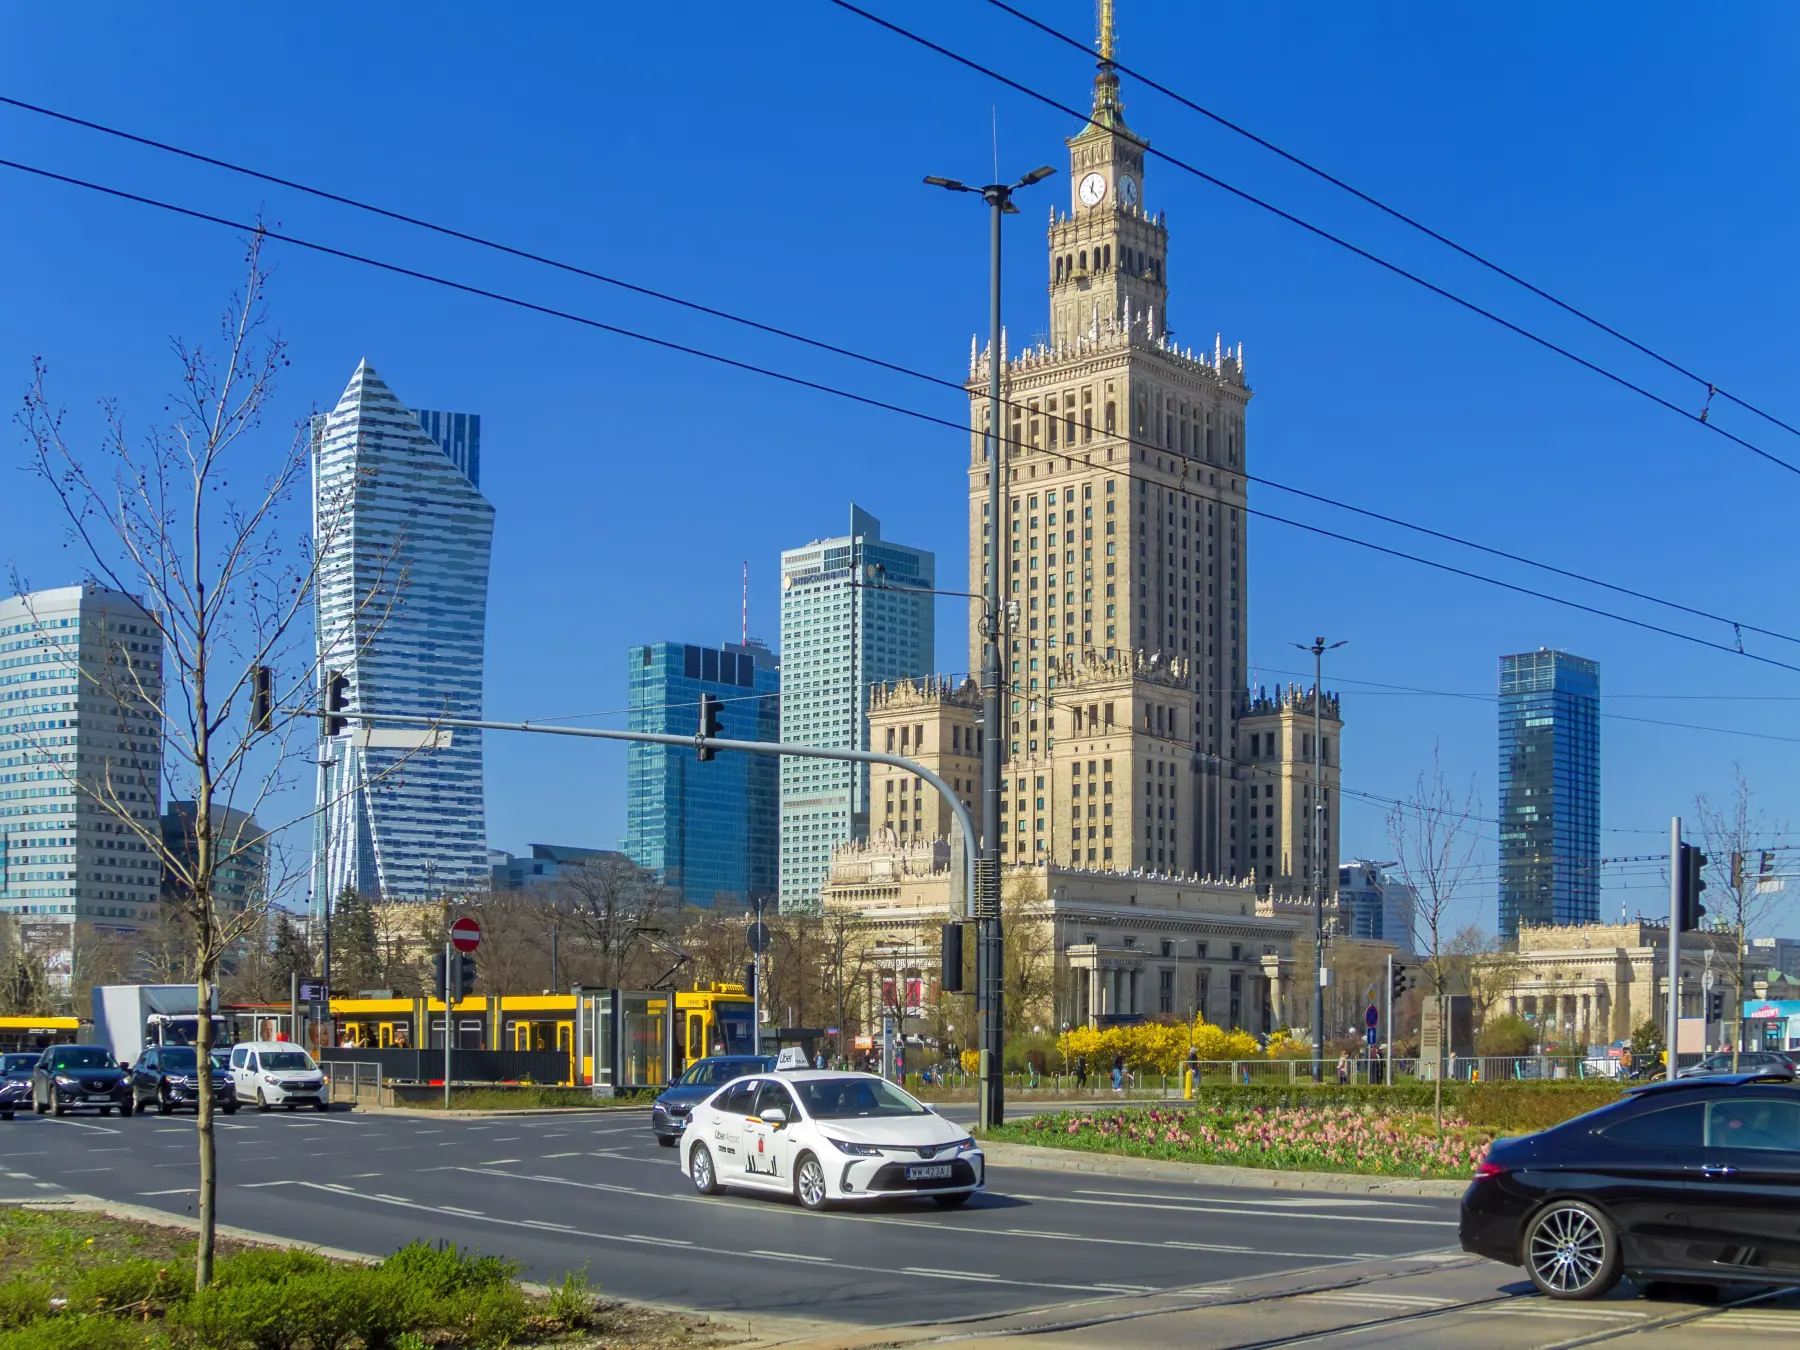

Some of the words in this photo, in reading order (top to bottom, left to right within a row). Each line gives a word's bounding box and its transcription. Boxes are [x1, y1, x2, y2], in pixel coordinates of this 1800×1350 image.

[780, 1053, 793, 1064] Uber
[714, 1130, 726, 1141] Uber
[726, 1132, 740, 1144] Airport
